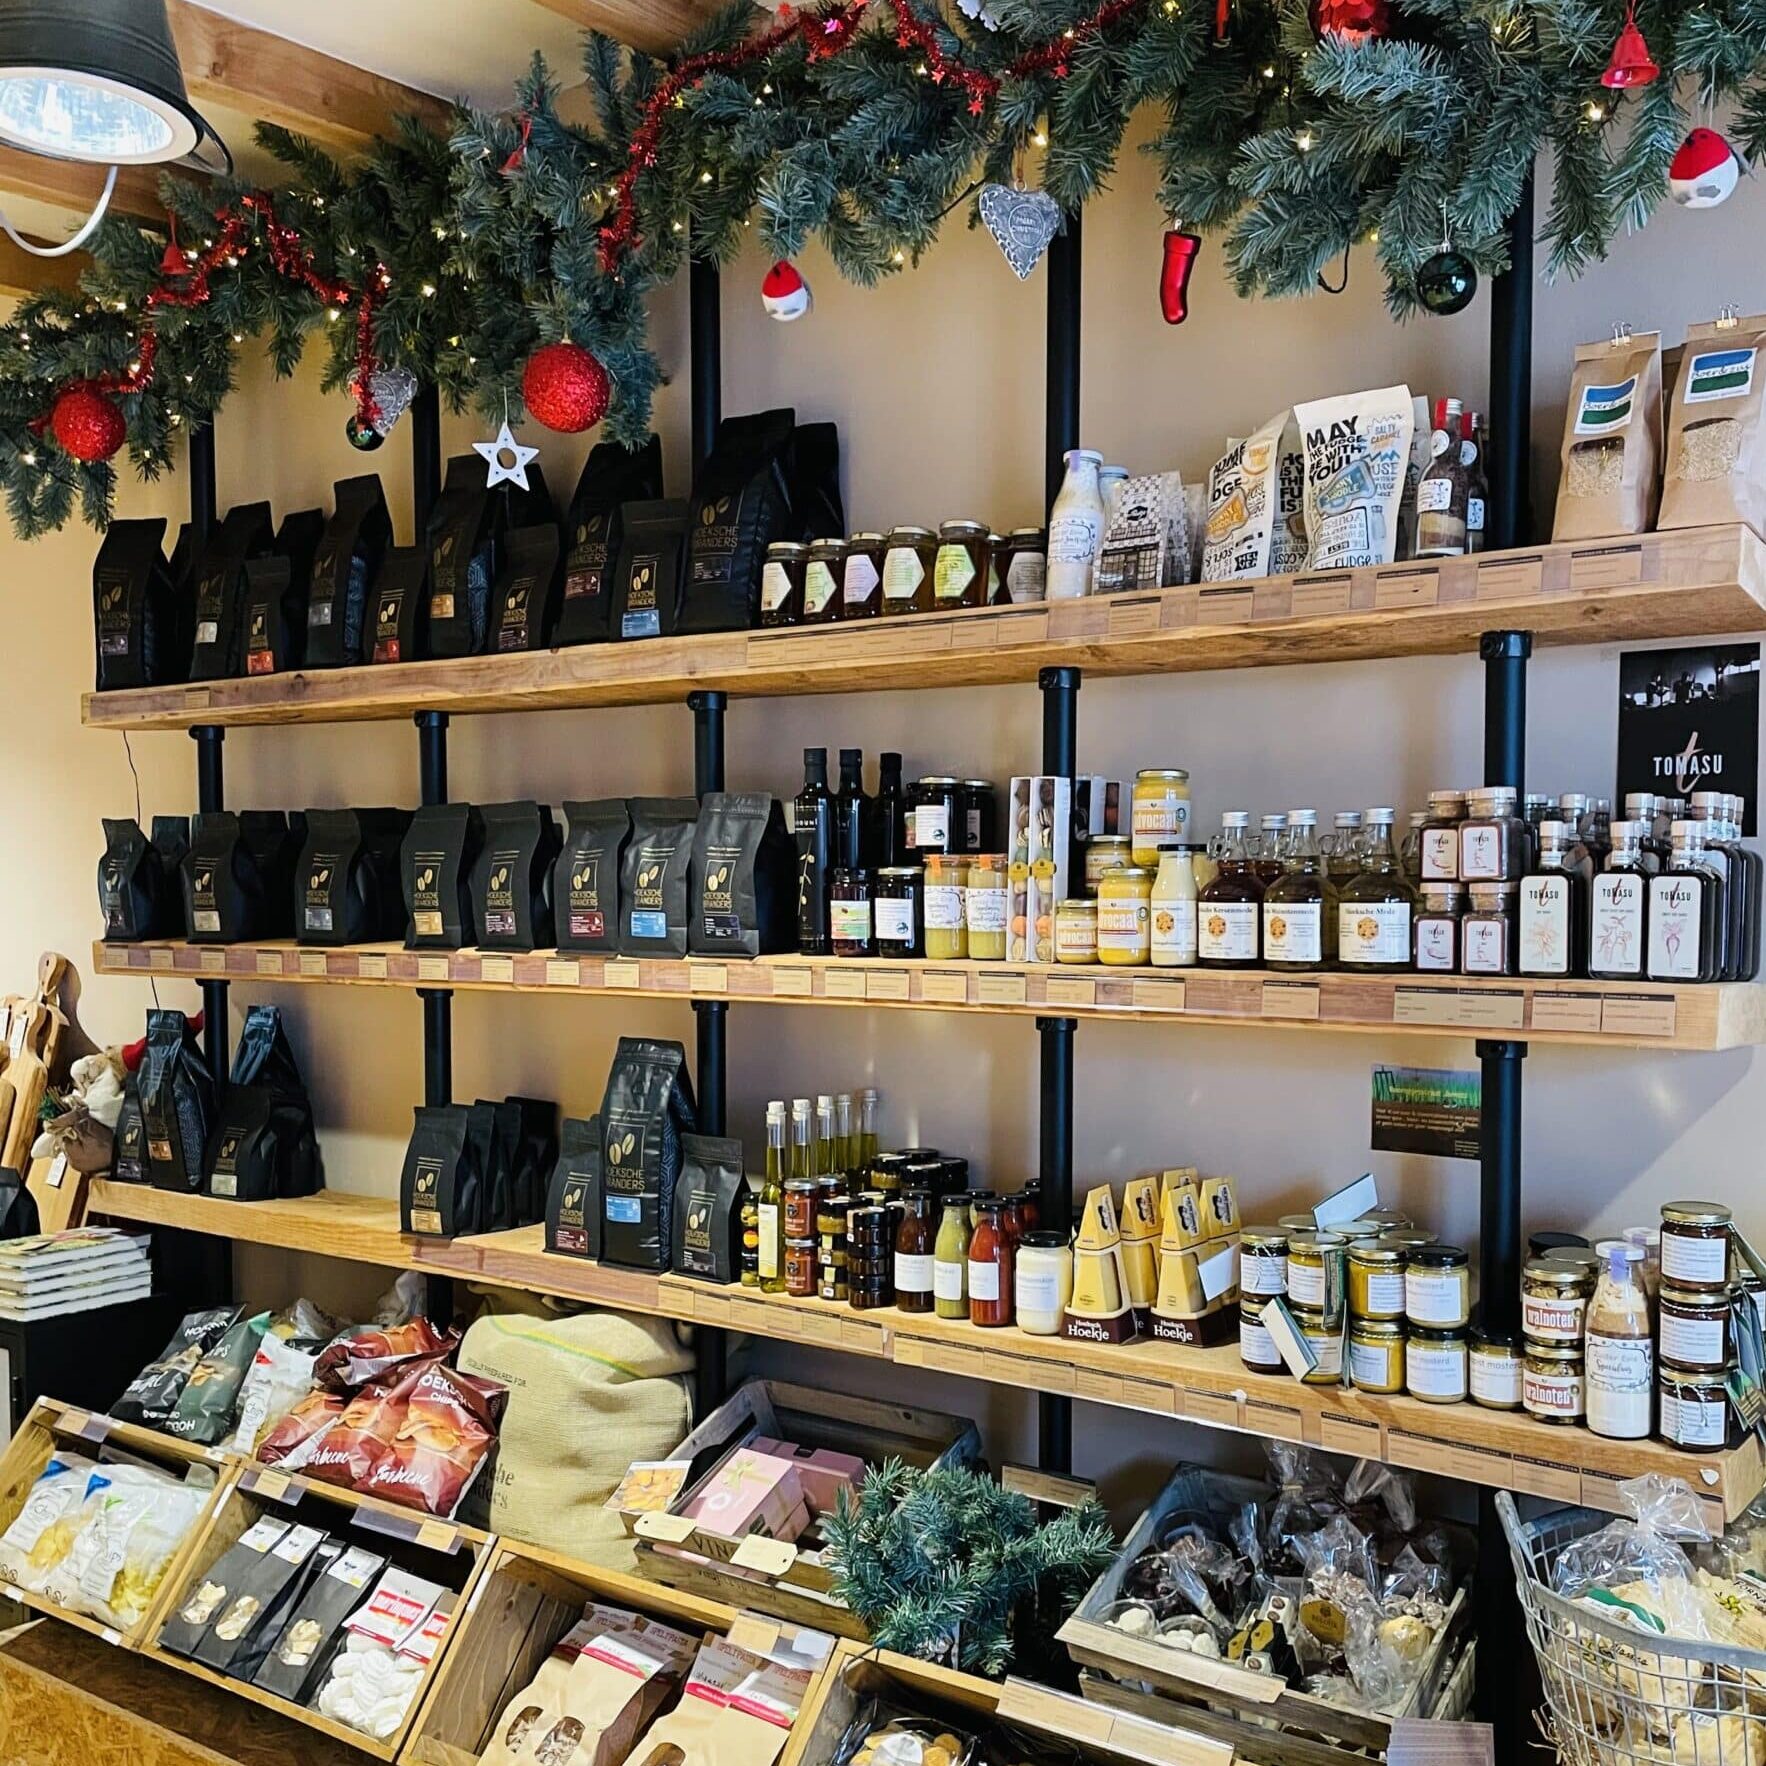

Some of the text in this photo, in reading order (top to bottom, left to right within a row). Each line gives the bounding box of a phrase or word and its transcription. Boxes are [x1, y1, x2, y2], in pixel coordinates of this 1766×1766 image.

[1307, 416, 1358, 452] MAY
[1325, 434, 1363, 453] FUDGE
[1309, 443, 1363, 474] BE WITH
[1374, 461, 1399, 476] USE
[1309, 457, 1352, 487] YOU!
[1653, 755, 1723, 777] TOMASU
[1527, 1309, 1574, 1329] walnoten
[1068, 1324, 1110, 1342] Hoekje
[1153, 1324, 1193, 1342] Hoekje
[1525, 1384, 1571, 1405] walnoten
